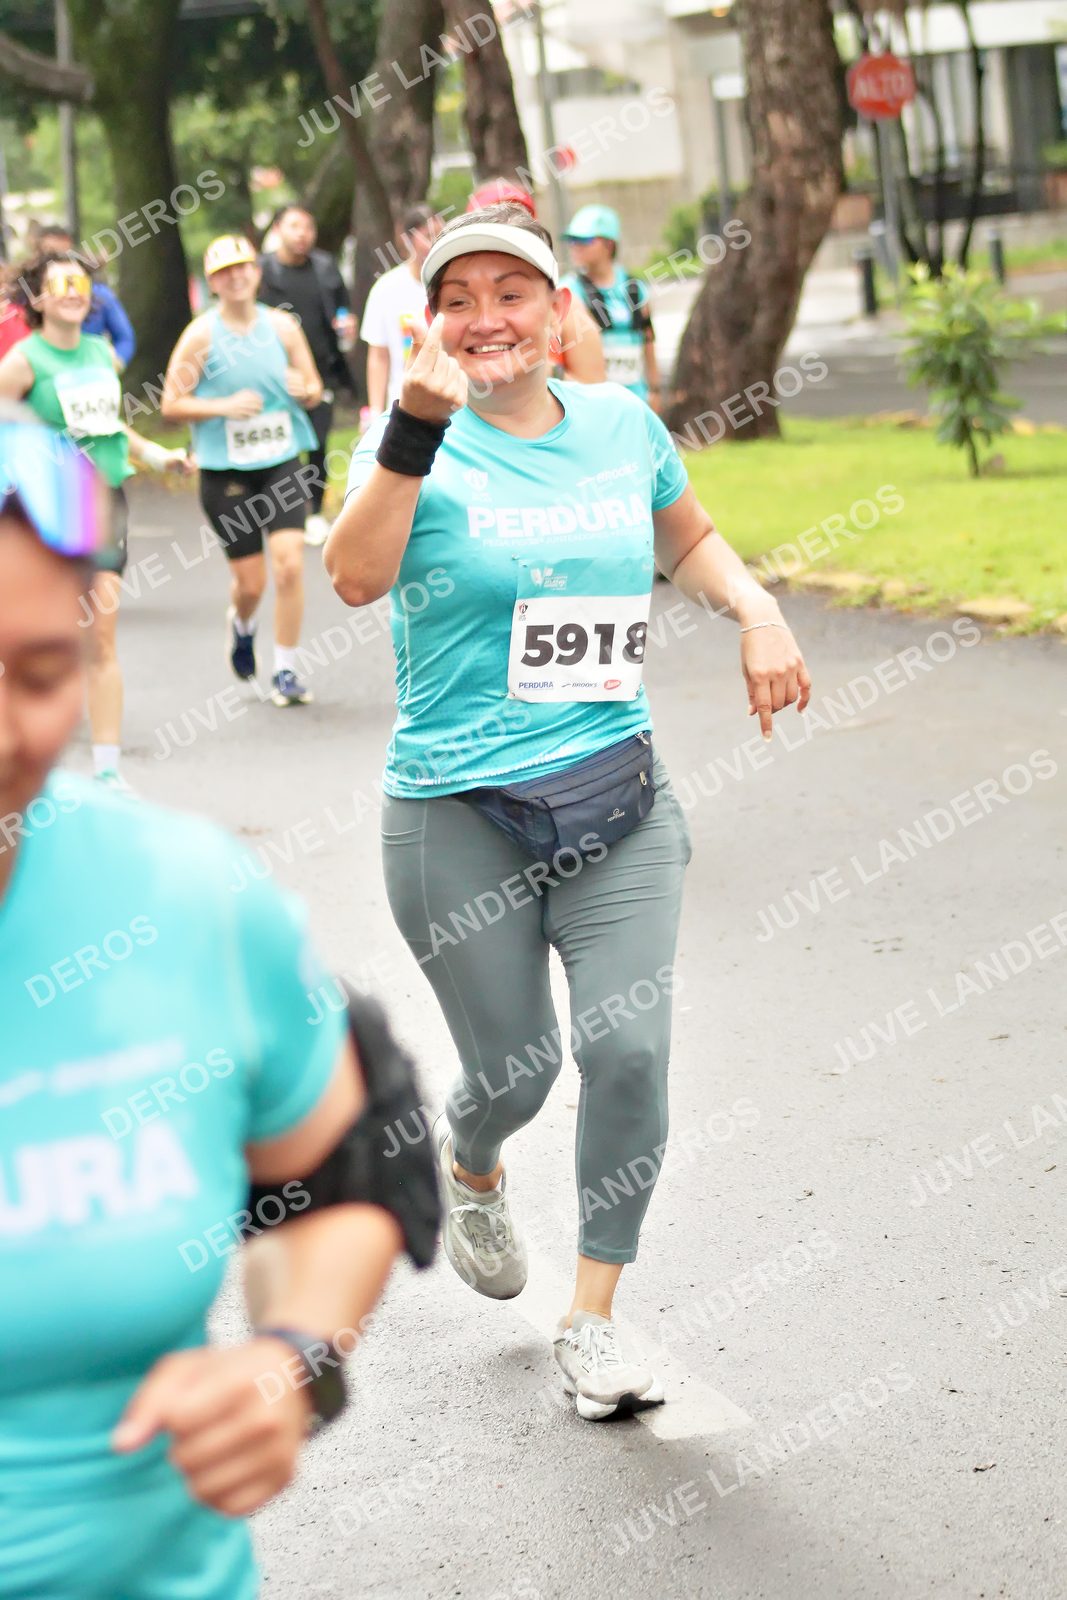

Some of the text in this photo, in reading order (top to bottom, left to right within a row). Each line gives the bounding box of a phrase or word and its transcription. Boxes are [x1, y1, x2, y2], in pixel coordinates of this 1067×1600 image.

[855, 72, 911, 99] ALTO
[467, 493, 651, 539] PERDURA
[520, 621, 648, 667] 5918
[518, 681, 554, 690] PERDURA
